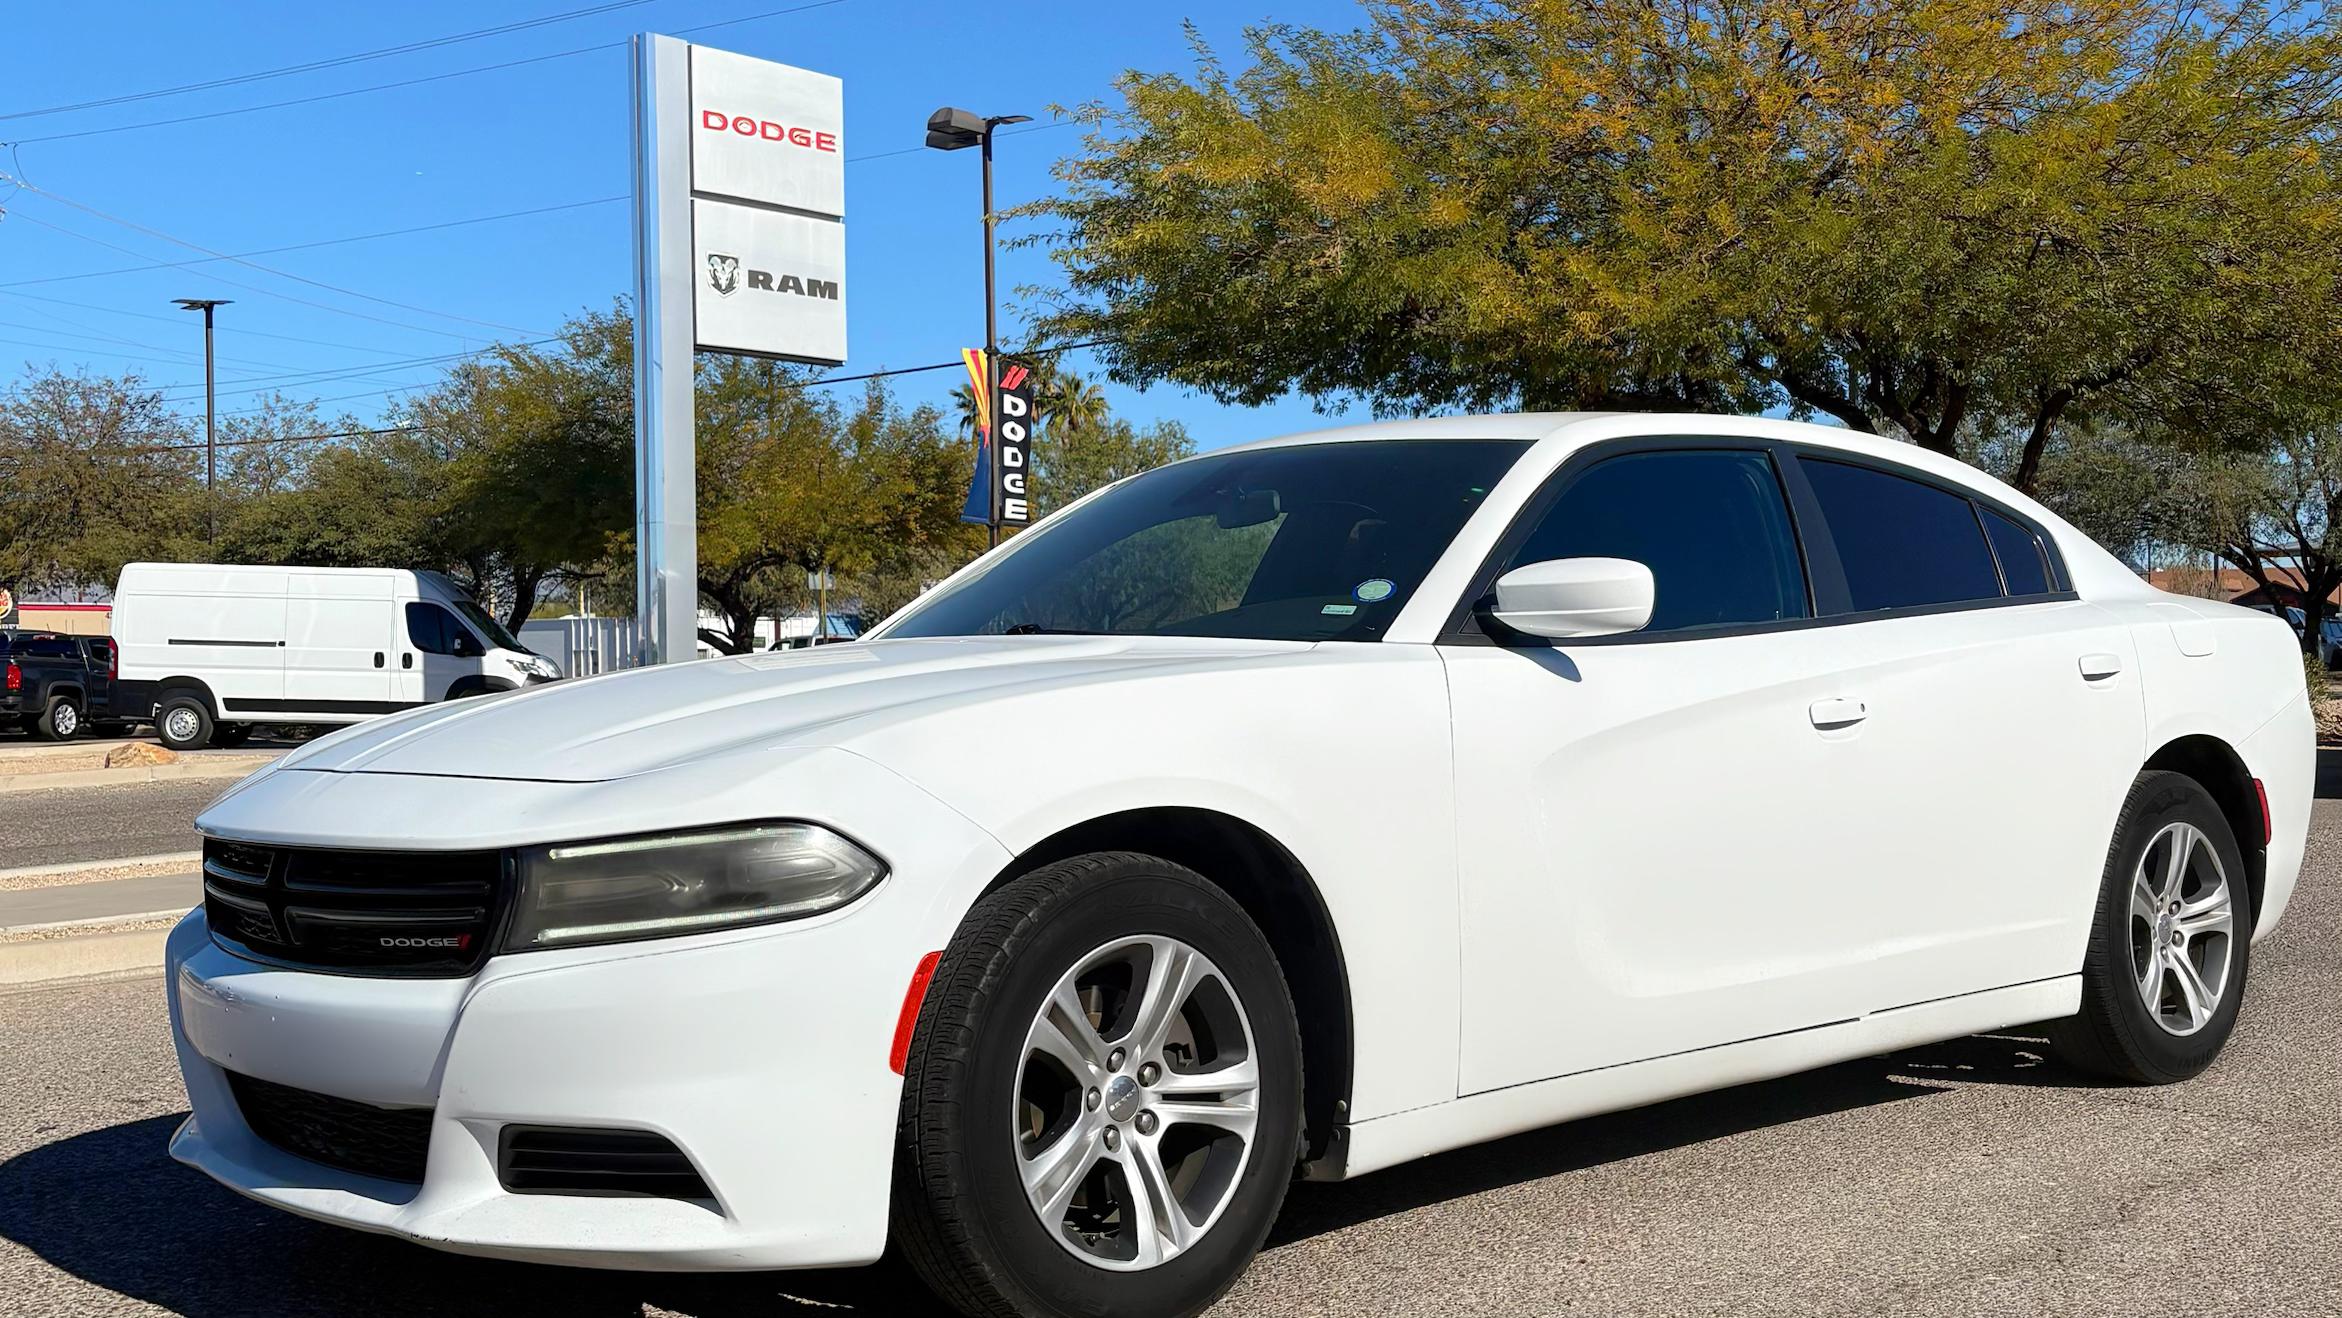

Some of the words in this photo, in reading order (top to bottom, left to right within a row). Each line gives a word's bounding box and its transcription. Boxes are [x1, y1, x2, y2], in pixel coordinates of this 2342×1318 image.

[703, 110, 836, 153] DODGE
[748, 269, 838, 300] RAM
[1002, 393, 1028, 521] DODGE
[380, 937, 459, 947] DODGE
